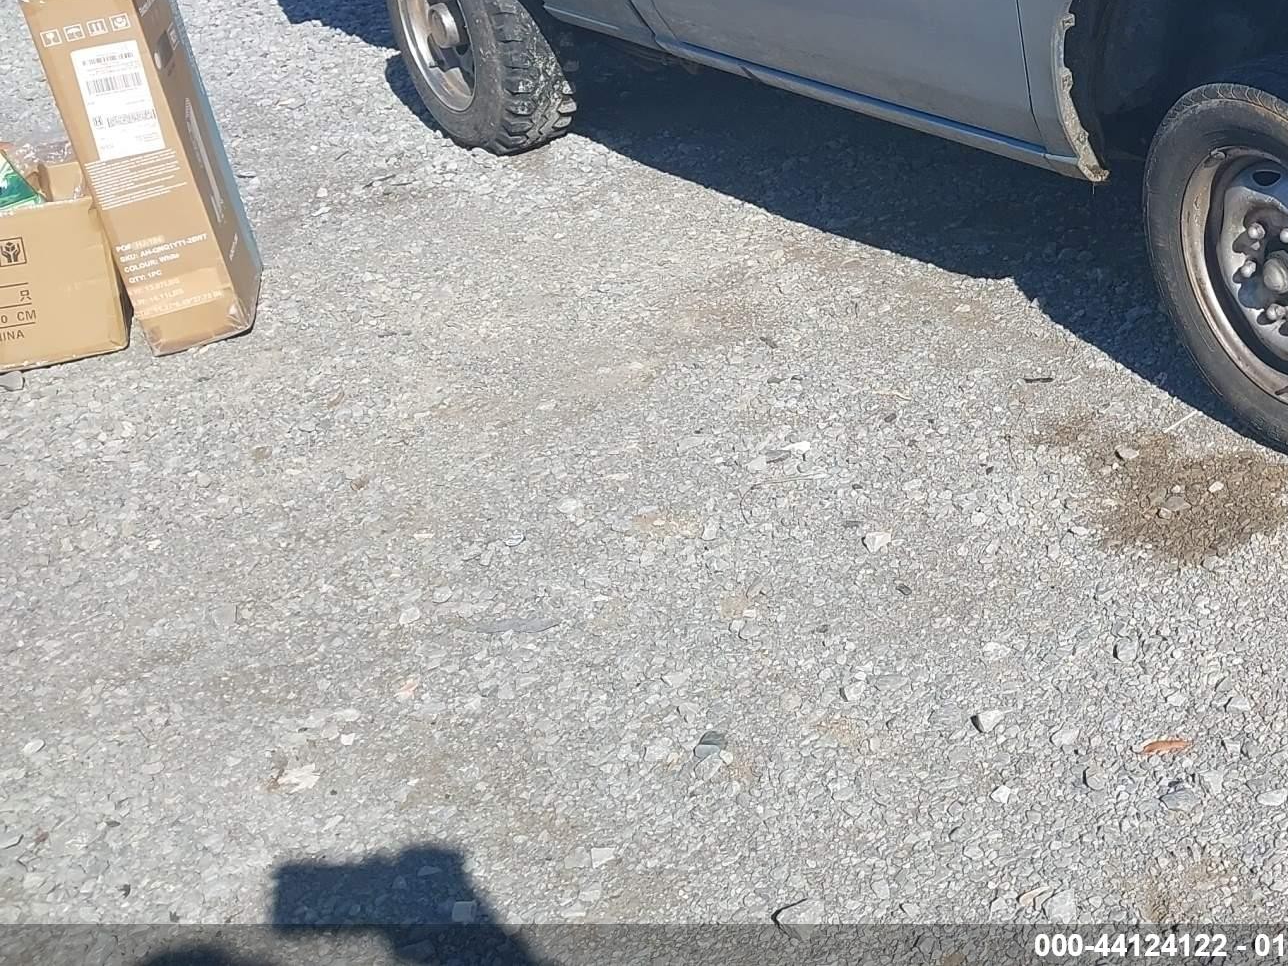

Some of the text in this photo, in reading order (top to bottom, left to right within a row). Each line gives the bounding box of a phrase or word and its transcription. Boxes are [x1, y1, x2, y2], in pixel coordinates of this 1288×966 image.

[20, 289, 32, 302] 只
[17, 310, 37, 322] CM
[0, 329, 25, 342] INA
